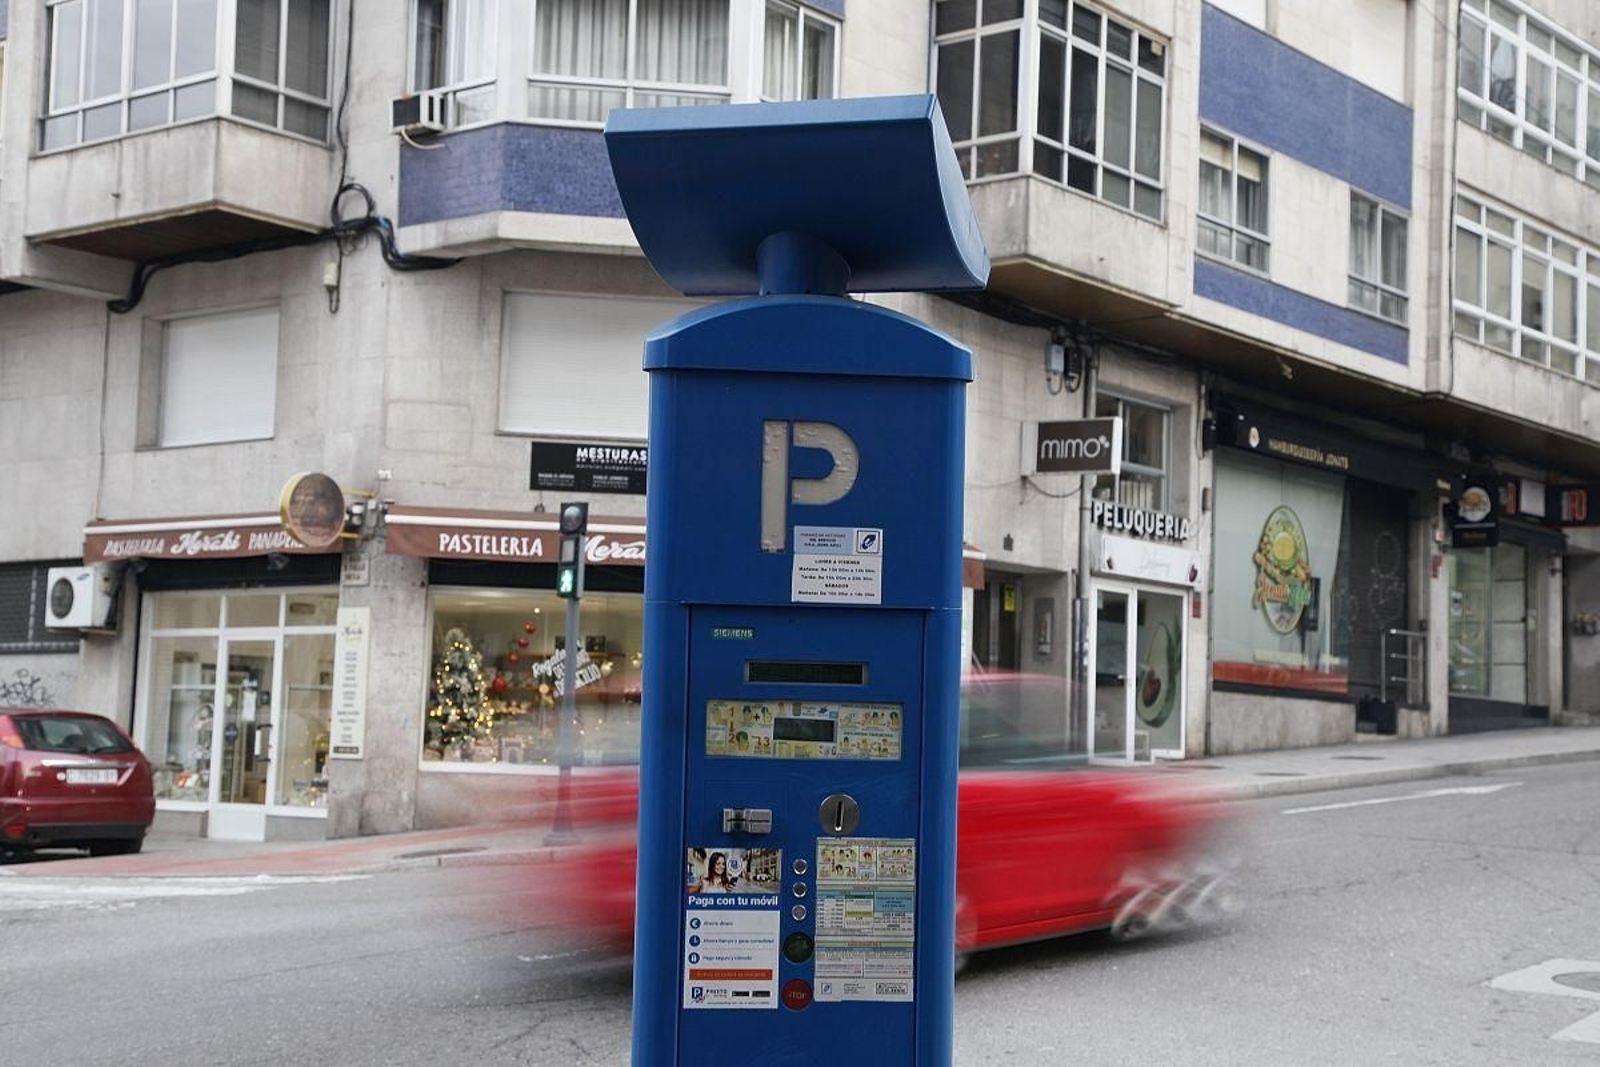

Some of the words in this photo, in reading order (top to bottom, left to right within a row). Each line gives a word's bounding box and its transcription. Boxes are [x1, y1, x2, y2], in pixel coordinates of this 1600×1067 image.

[576, 447, 647, 461] MESTURAS
[1041, 437, 1101, 459] mimo
[761, 420, 860, 551] P
[1093, 500, 1191, 540] PELUQUERIA
[247, 531, 305, 550] PANADER
[439, 532, 543, 557] PASTELERIA
[584, 534, 646, 562] Mera
[713, 628, 753, 638] SIEMENS
[688, 895, 714, 908] Paga
[716, 897, 735, 906] con
[738, 896, 747, 906] tu
[750, 895, 778, 906] móvil
[788, 991, 807, 1000] TO
